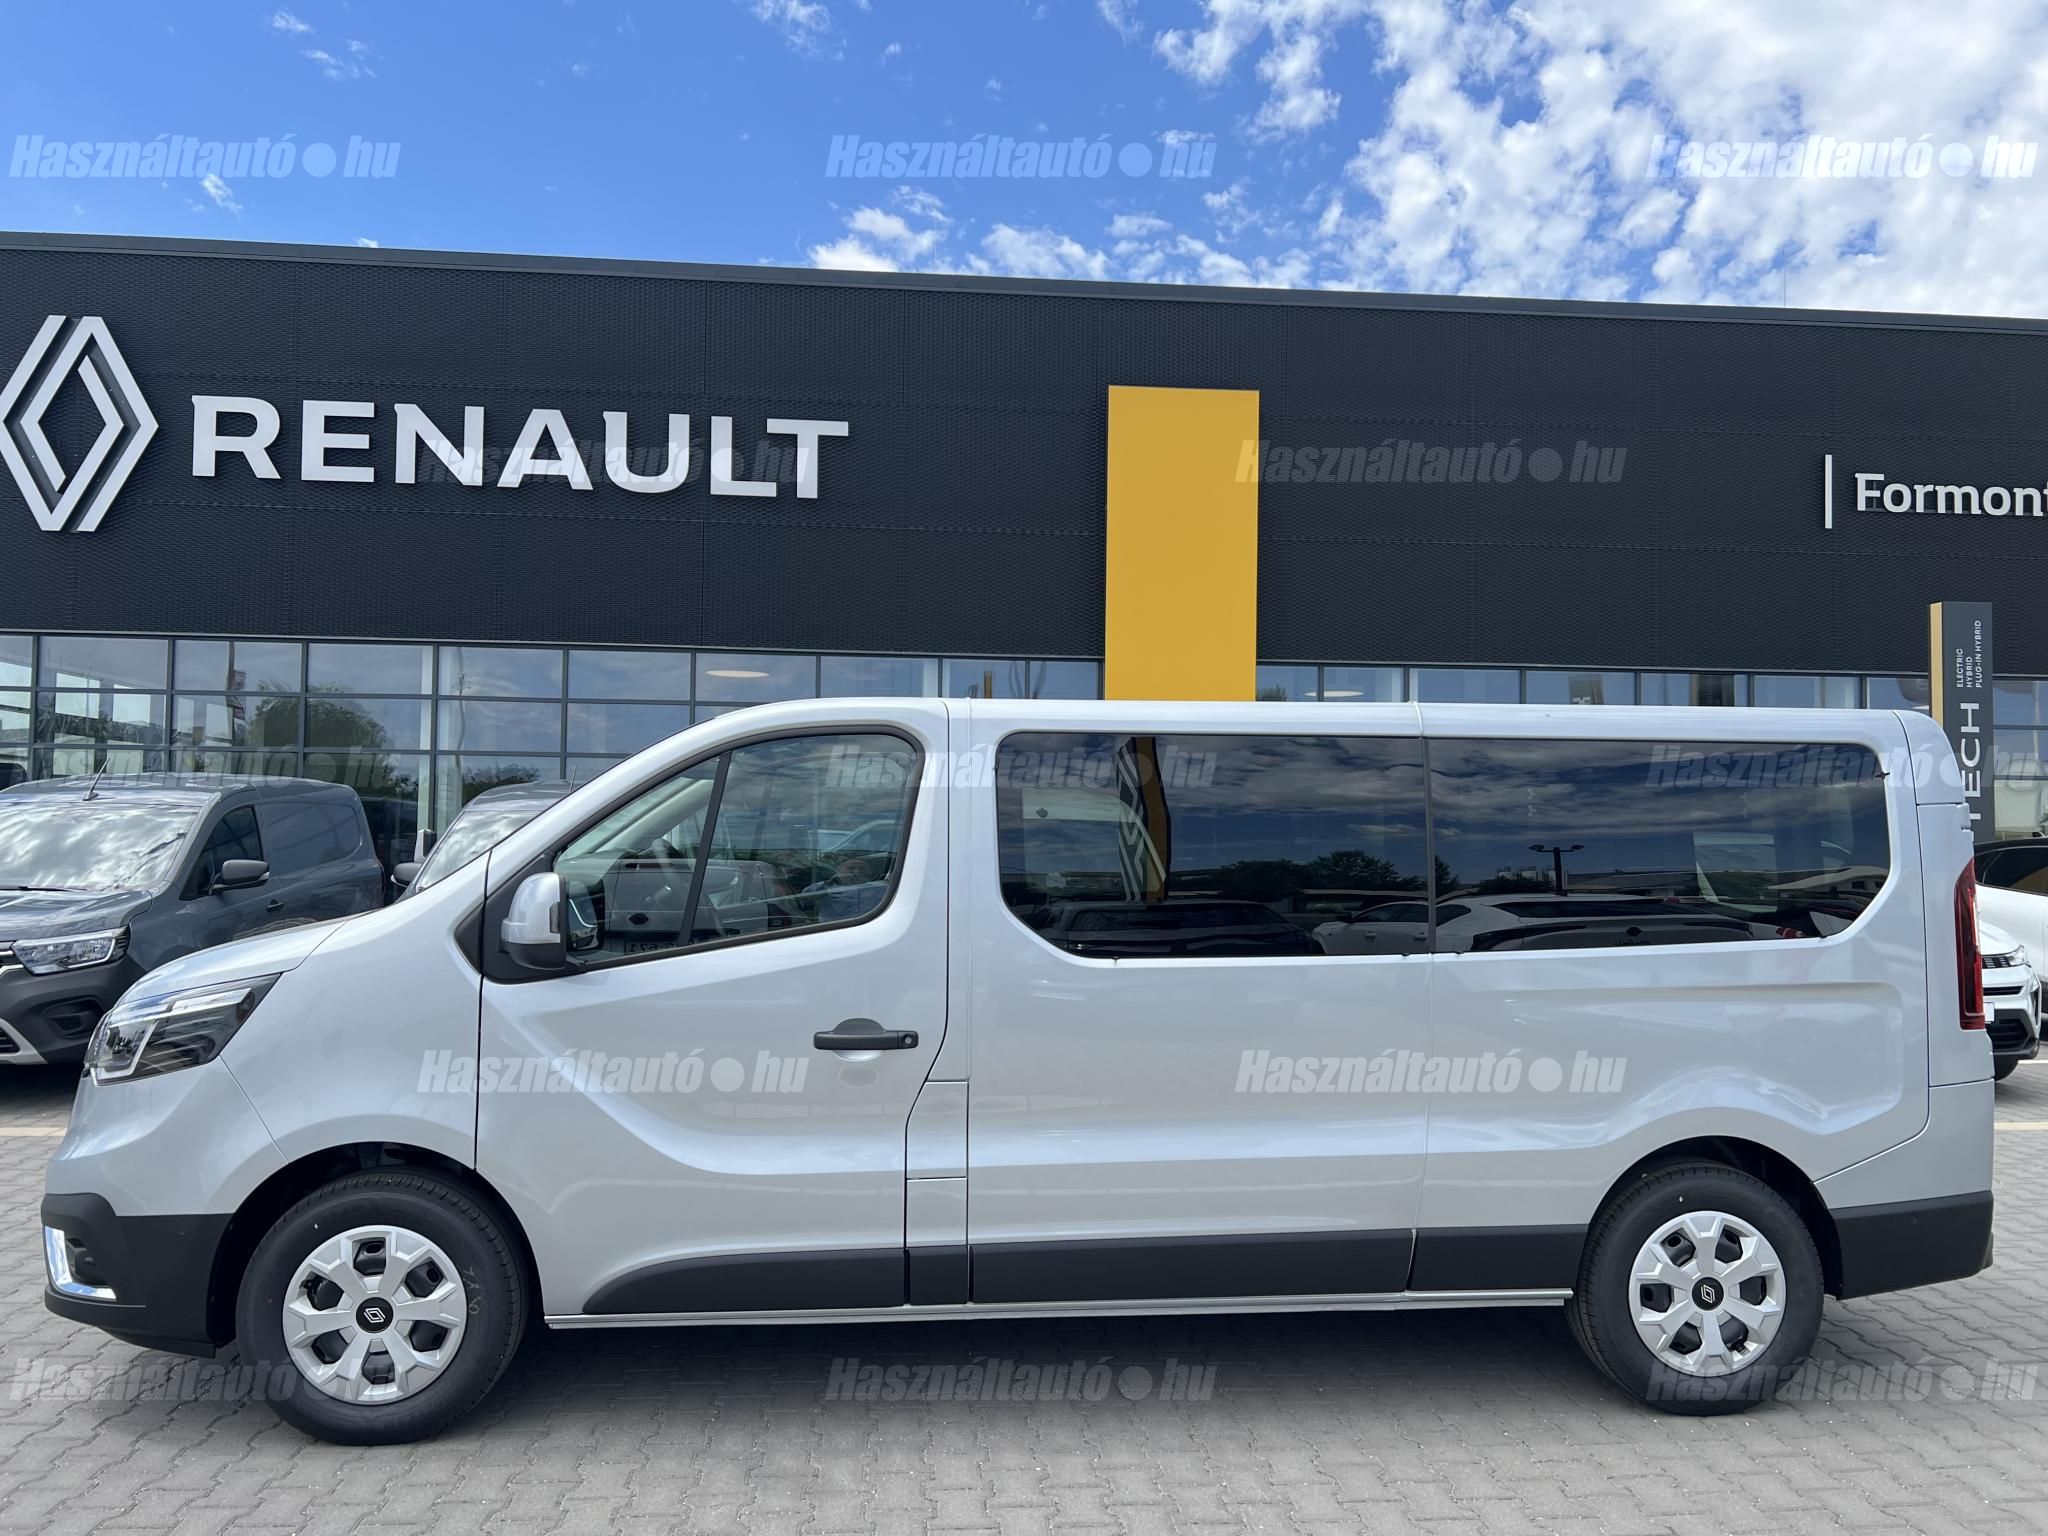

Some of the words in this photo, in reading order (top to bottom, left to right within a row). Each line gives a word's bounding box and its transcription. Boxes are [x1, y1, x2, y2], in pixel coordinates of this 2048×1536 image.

[191, 394, 849, 499] RENAULT
[1855, 472, 2048, 517] Formon
[1974, 620, 1982, 652] HYBRID
[1956, 648, 1964, 688] ELECTRIC
[1965, 656, 1973, 688] HYBRID
